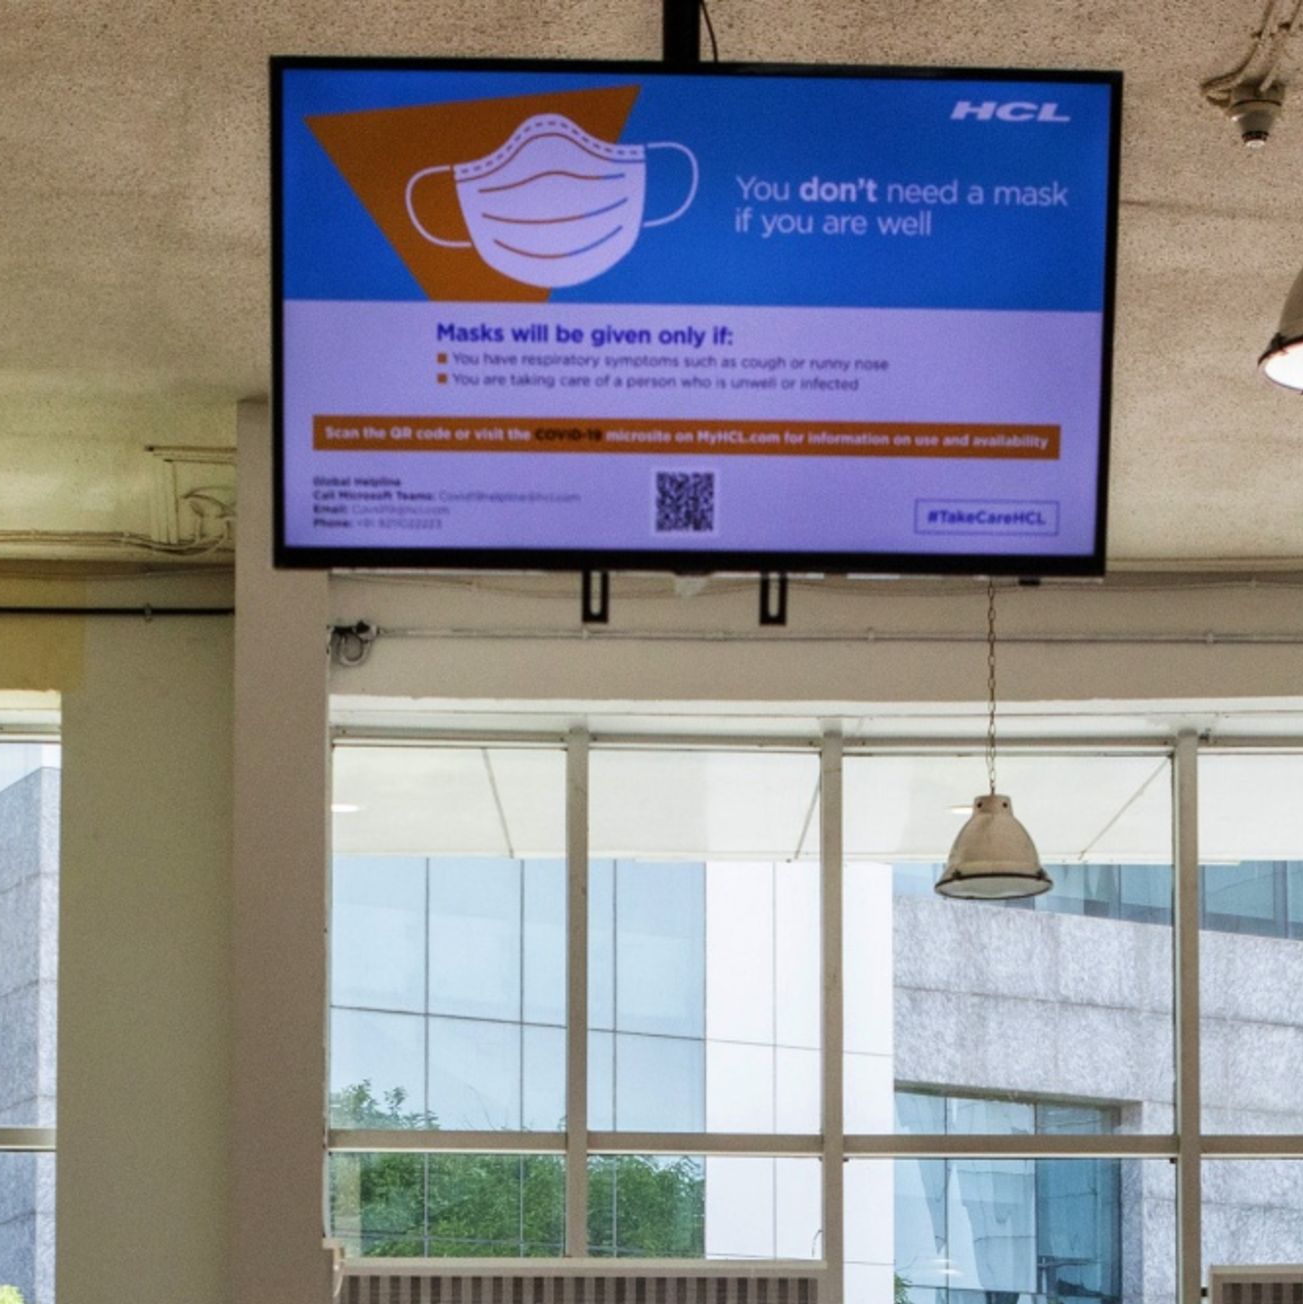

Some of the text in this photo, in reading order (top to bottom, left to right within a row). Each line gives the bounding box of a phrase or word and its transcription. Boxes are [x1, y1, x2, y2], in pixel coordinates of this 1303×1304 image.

[950, 101, 1071, 121] HCL
[736, 176, 1068, 207] You don't need a mask
[735, 207, 931, 238] if you are well
[436, 323, 733, 348] Masks will be given only if:
[452, 352, 889, 373] You have respiratory symptoms such as cough or runny nose
[452, 373, 859, 391] You are taking care of a person who is unwell or infected
[325, 426, 1049, 450] Scan the QR code or visit the COVID-19 microsite on MyHCL.com for information on use and availability
[928, 510, 1045, 525] #TakeCareHCL
